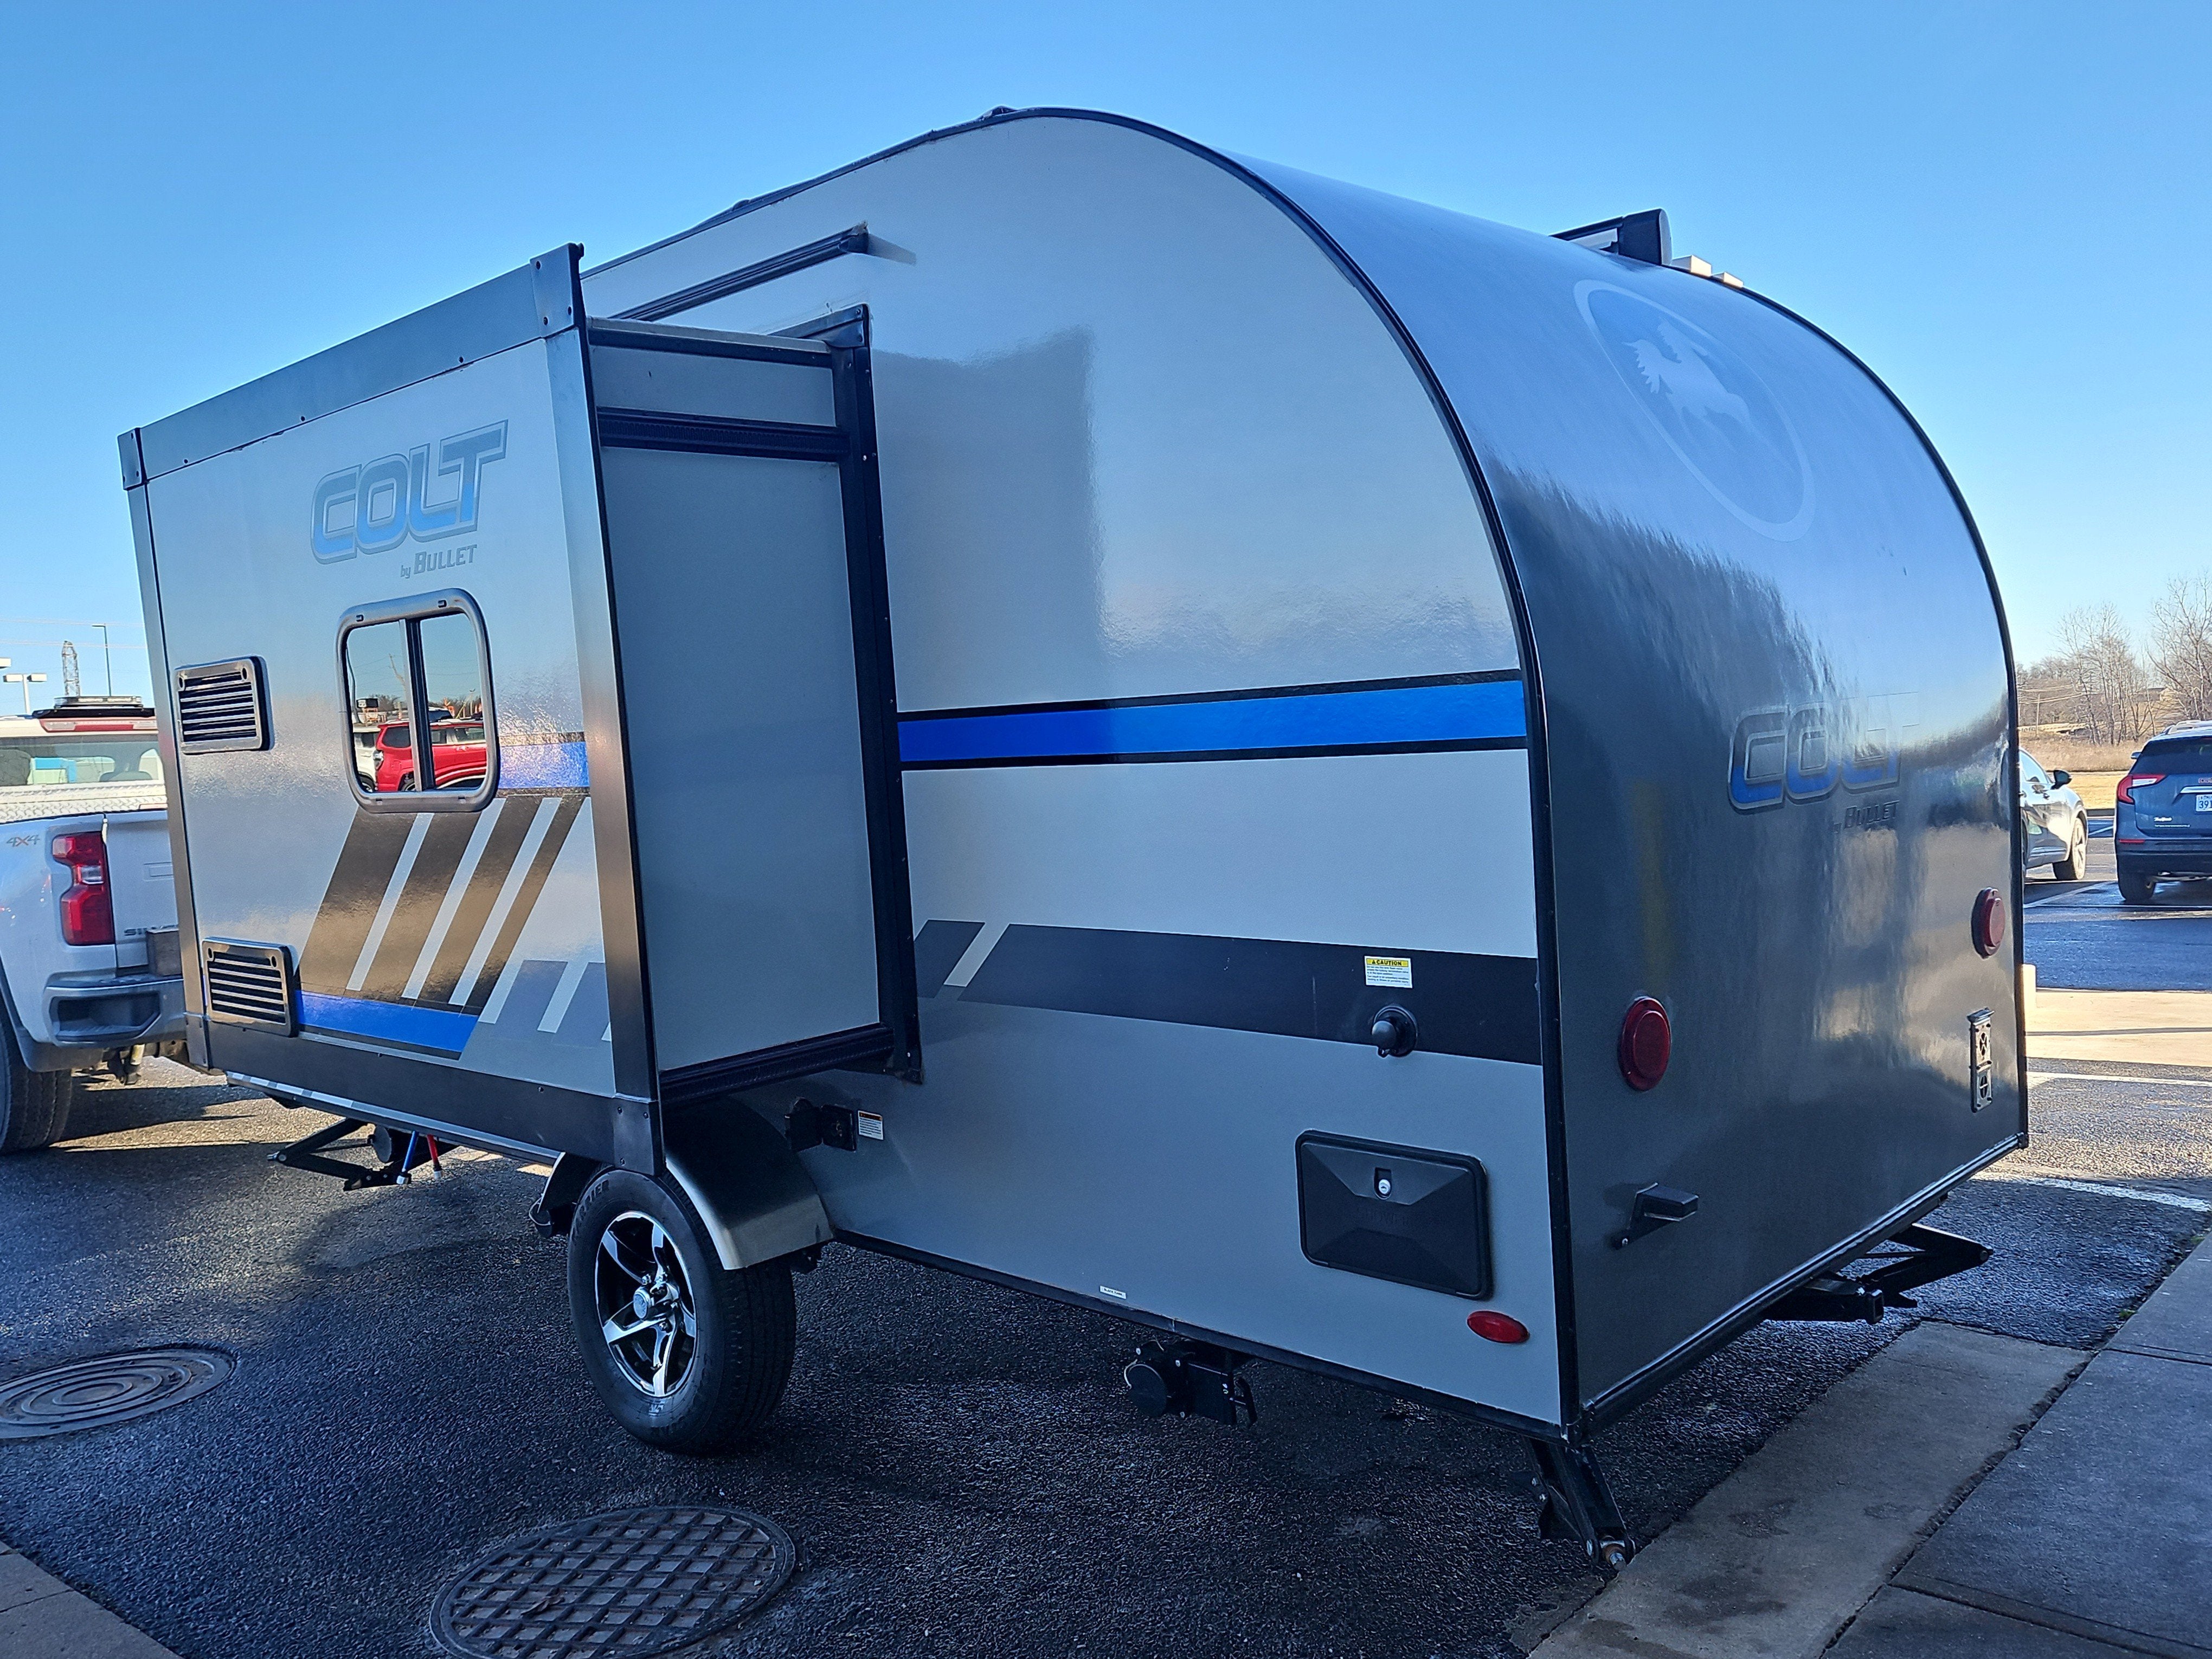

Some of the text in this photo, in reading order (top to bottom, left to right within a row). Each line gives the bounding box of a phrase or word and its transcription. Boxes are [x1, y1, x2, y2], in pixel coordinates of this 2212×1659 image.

[311, 419, 509, 564] COLT
[401, 565, 410, 578] by
[1727, 691, 1919, 815] COLT
